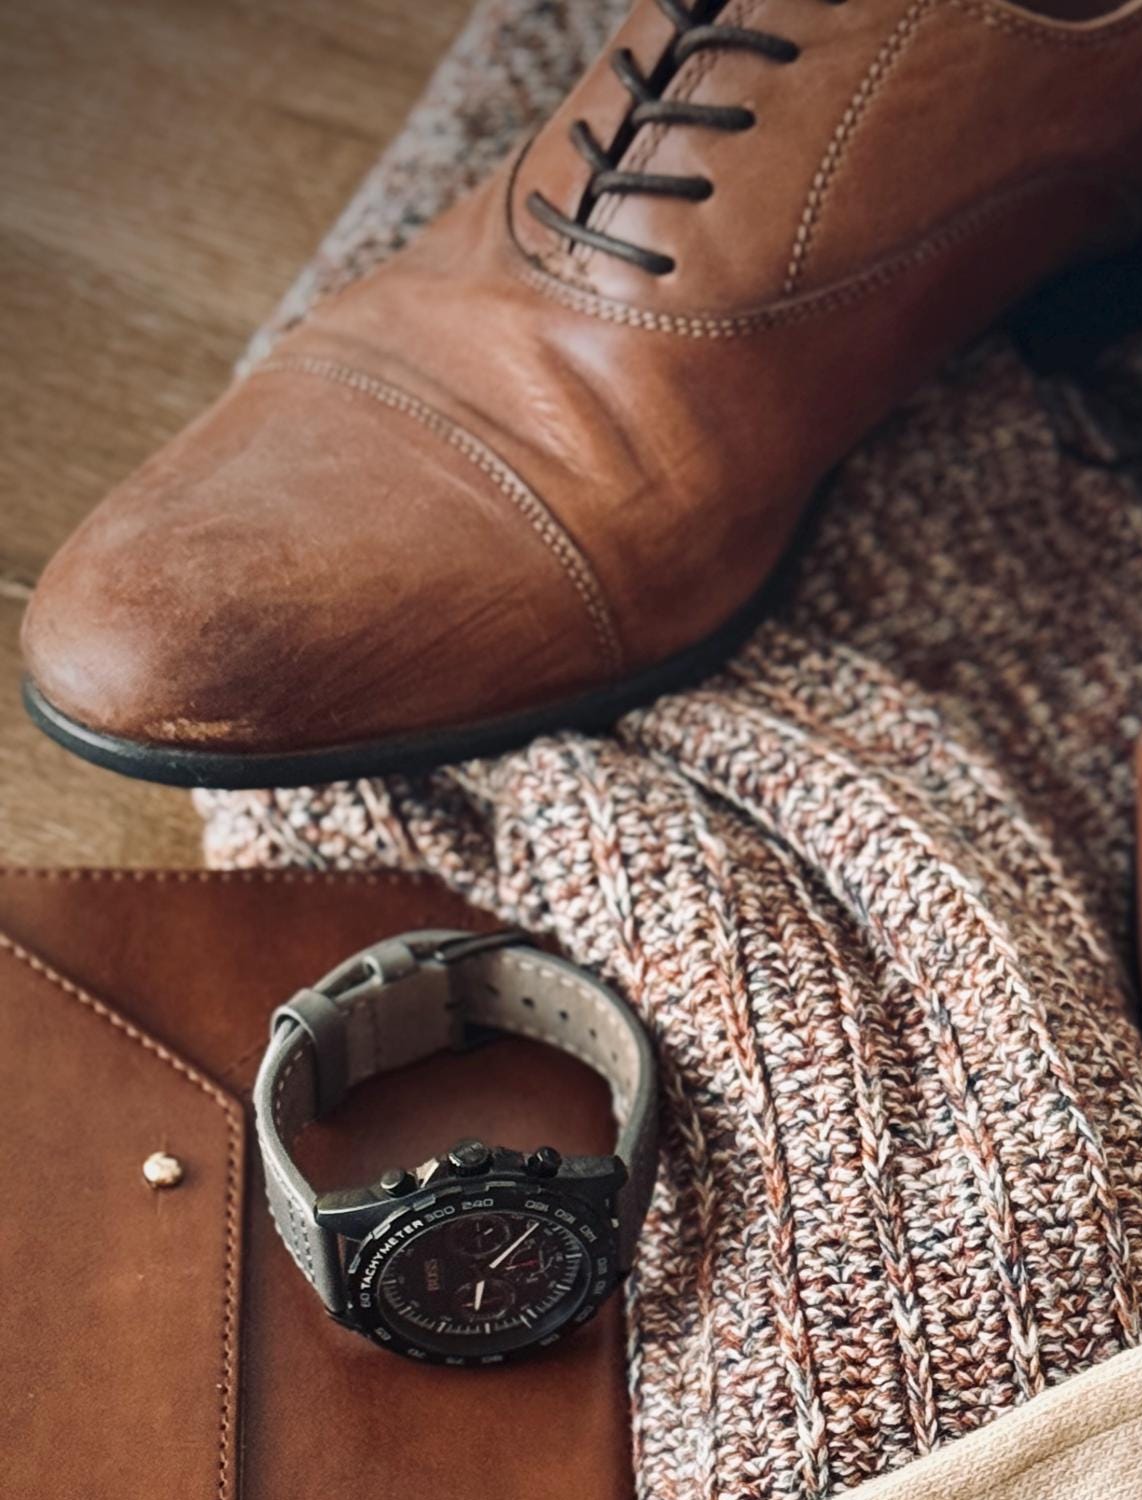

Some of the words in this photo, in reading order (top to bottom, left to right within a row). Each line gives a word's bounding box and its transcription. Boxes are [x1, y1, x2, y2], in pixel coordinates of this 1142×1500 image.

[424, 1205, 456, 1223] 300
[462, 1198, 494, 1211] 240
[360, 1219, 424, 1290] TACHYMETER
